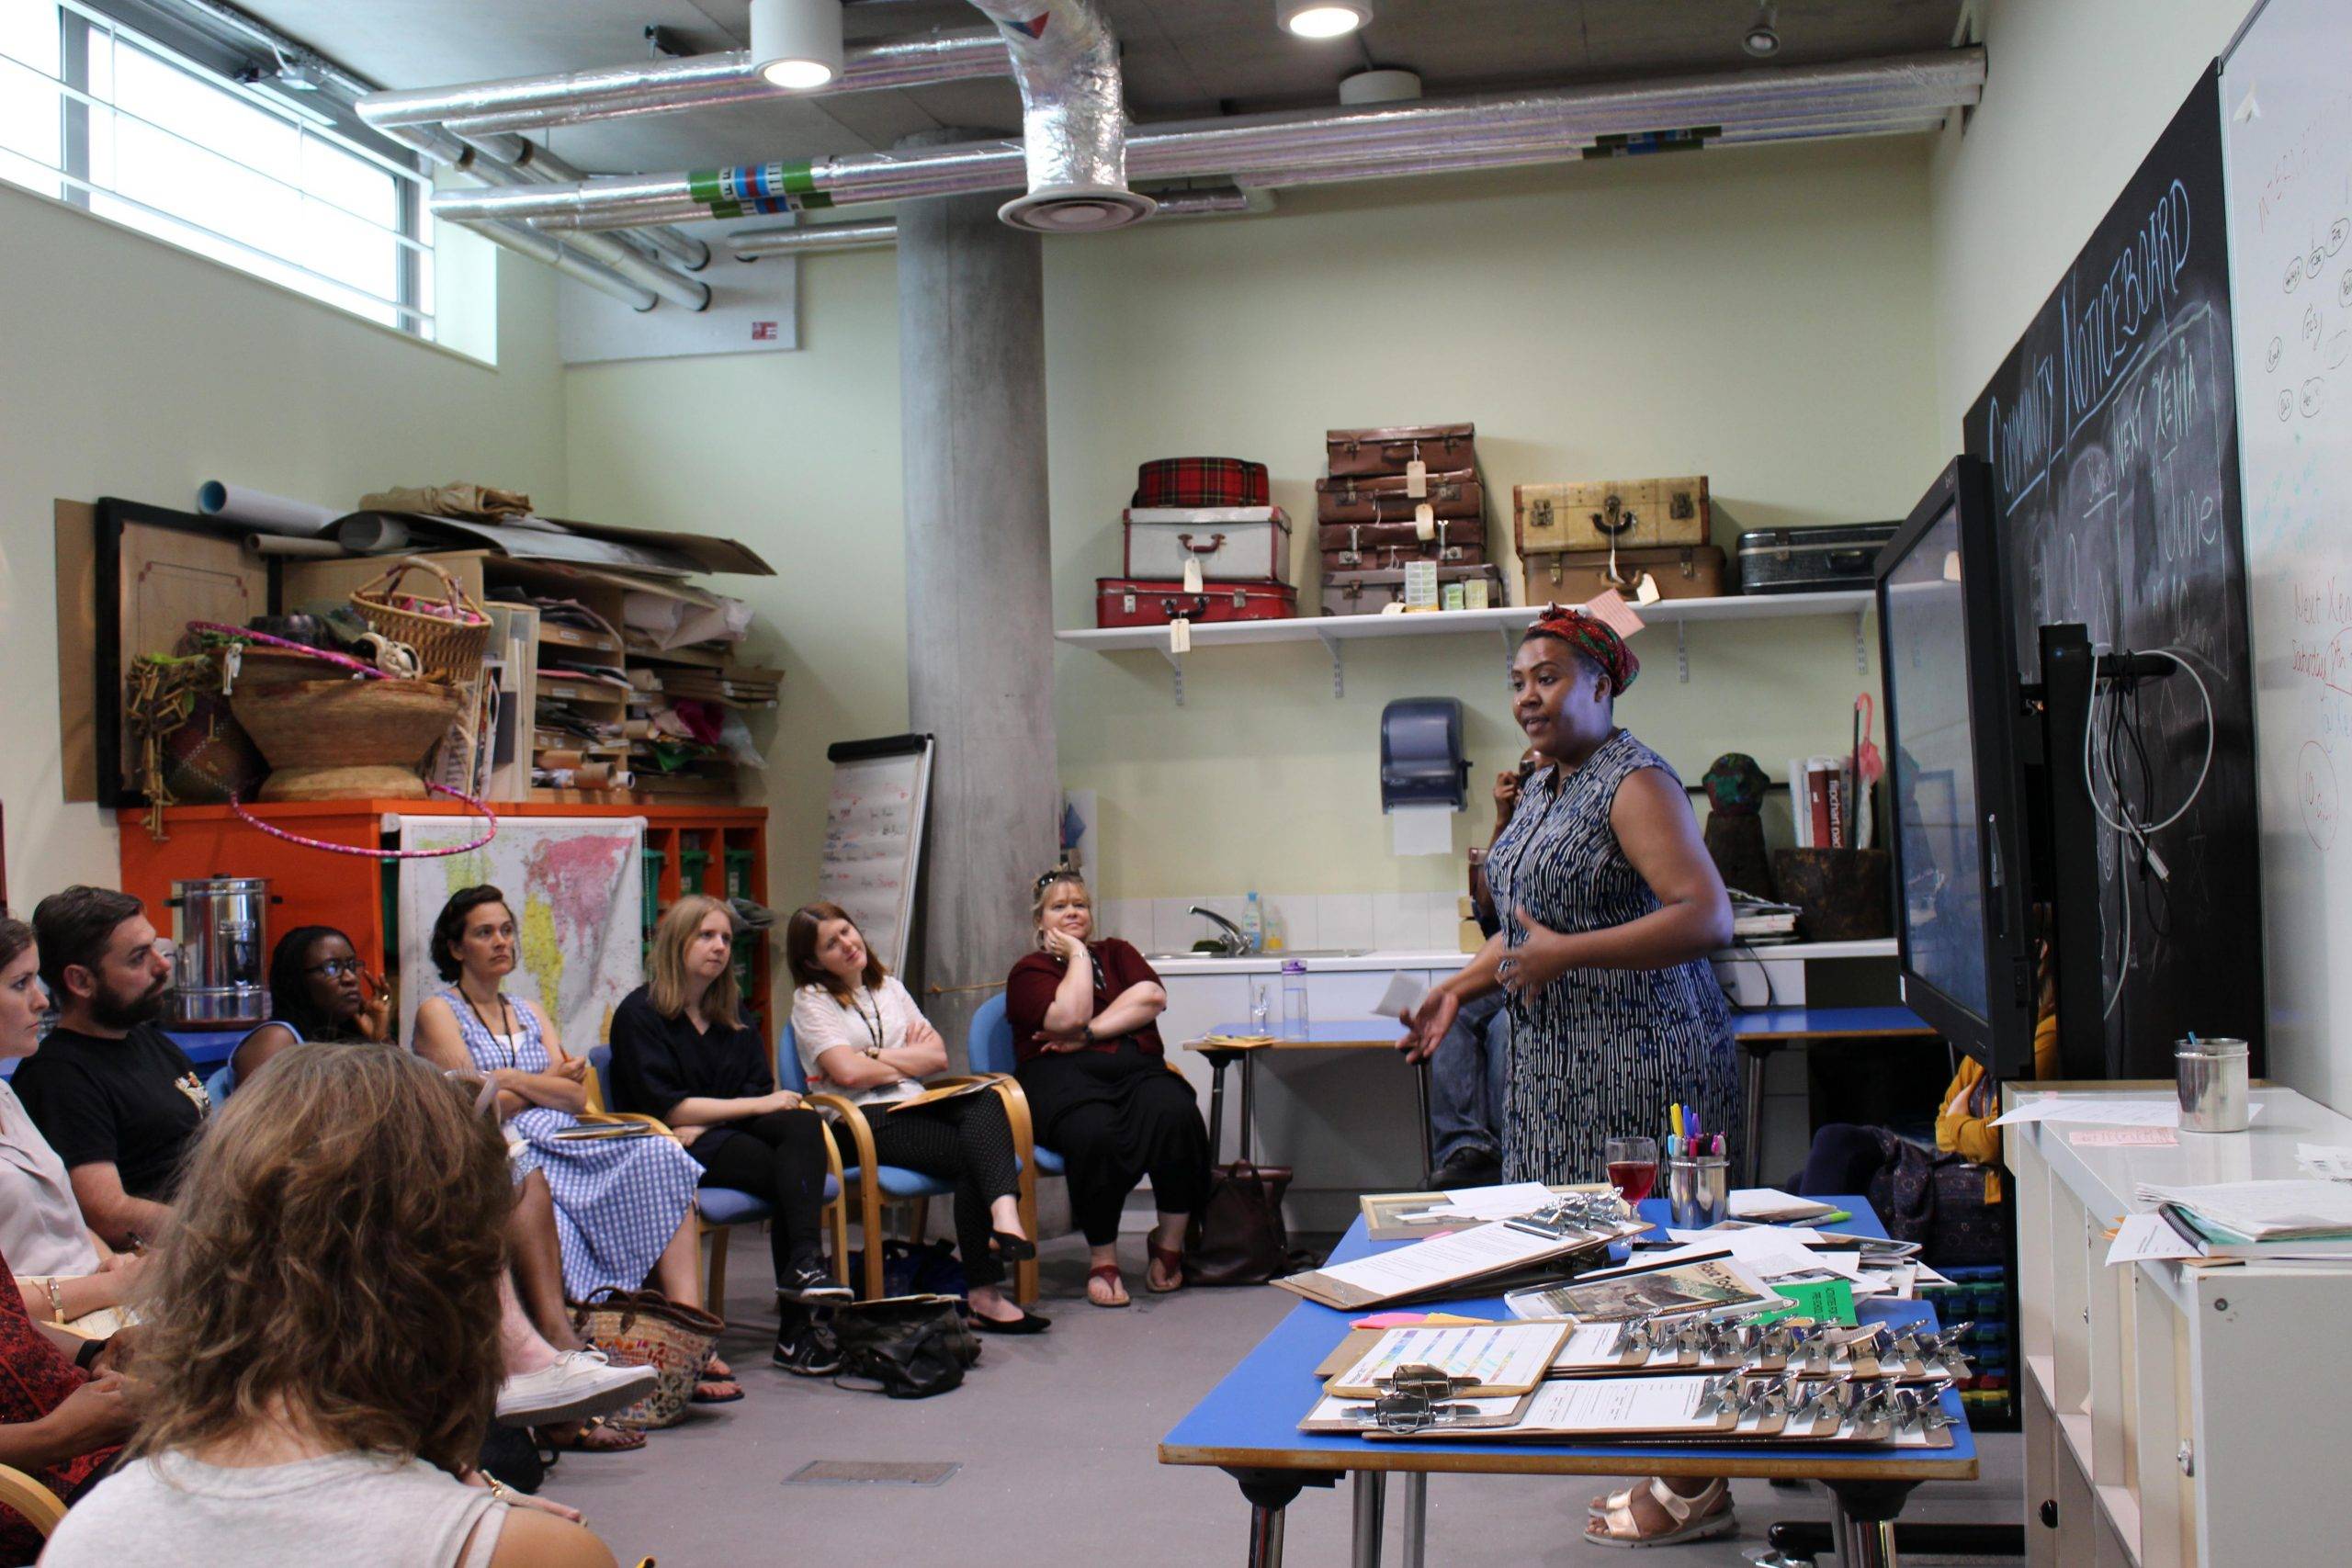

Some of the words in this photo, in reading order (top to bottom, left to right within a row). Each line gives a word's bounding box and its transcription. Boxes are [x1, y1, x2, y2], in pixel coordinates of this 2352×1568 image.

[1988, 353, 2053, 497] COMMUNITY
[2061, 178, 2190, 457] NOTICEBOARD
[2115, 386, 2145, 483] NEXT
[2162, 445, 2217, 562] June
[2294, 581, 2321, 626] Next
